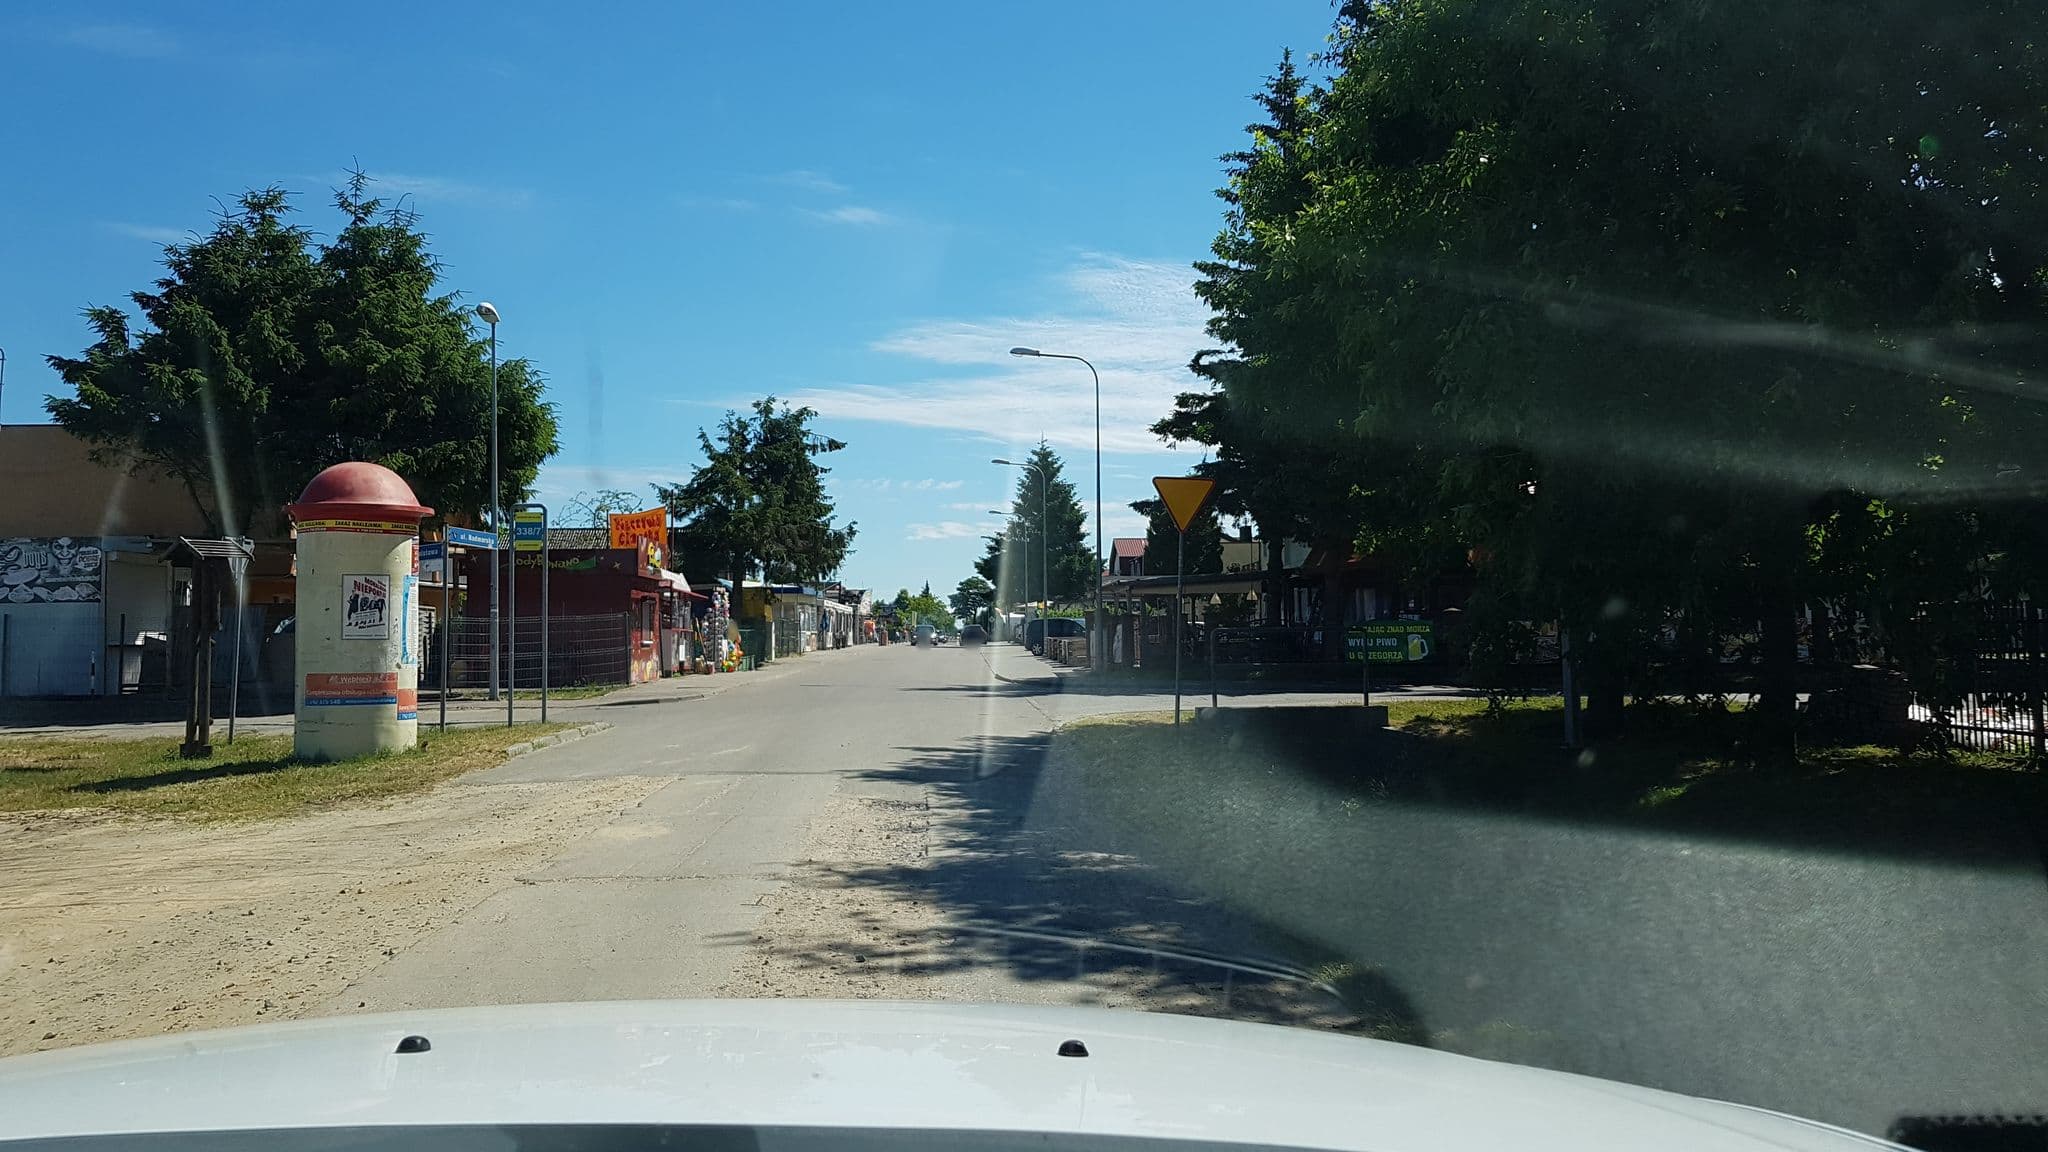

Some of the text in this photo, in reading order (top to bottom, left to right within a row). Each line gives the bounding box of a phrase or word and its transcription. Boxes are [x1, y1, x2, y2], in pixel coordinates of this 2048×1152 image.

[516, 527, 542, 537] 338/7
[1387, 625, 1405, 633] ZNAD
[1406, 625, 1431, 633] MORZA
[1376, 637, 1397, 647] PIWO
[1357, 651, 1403, 660] GZEGORZA
